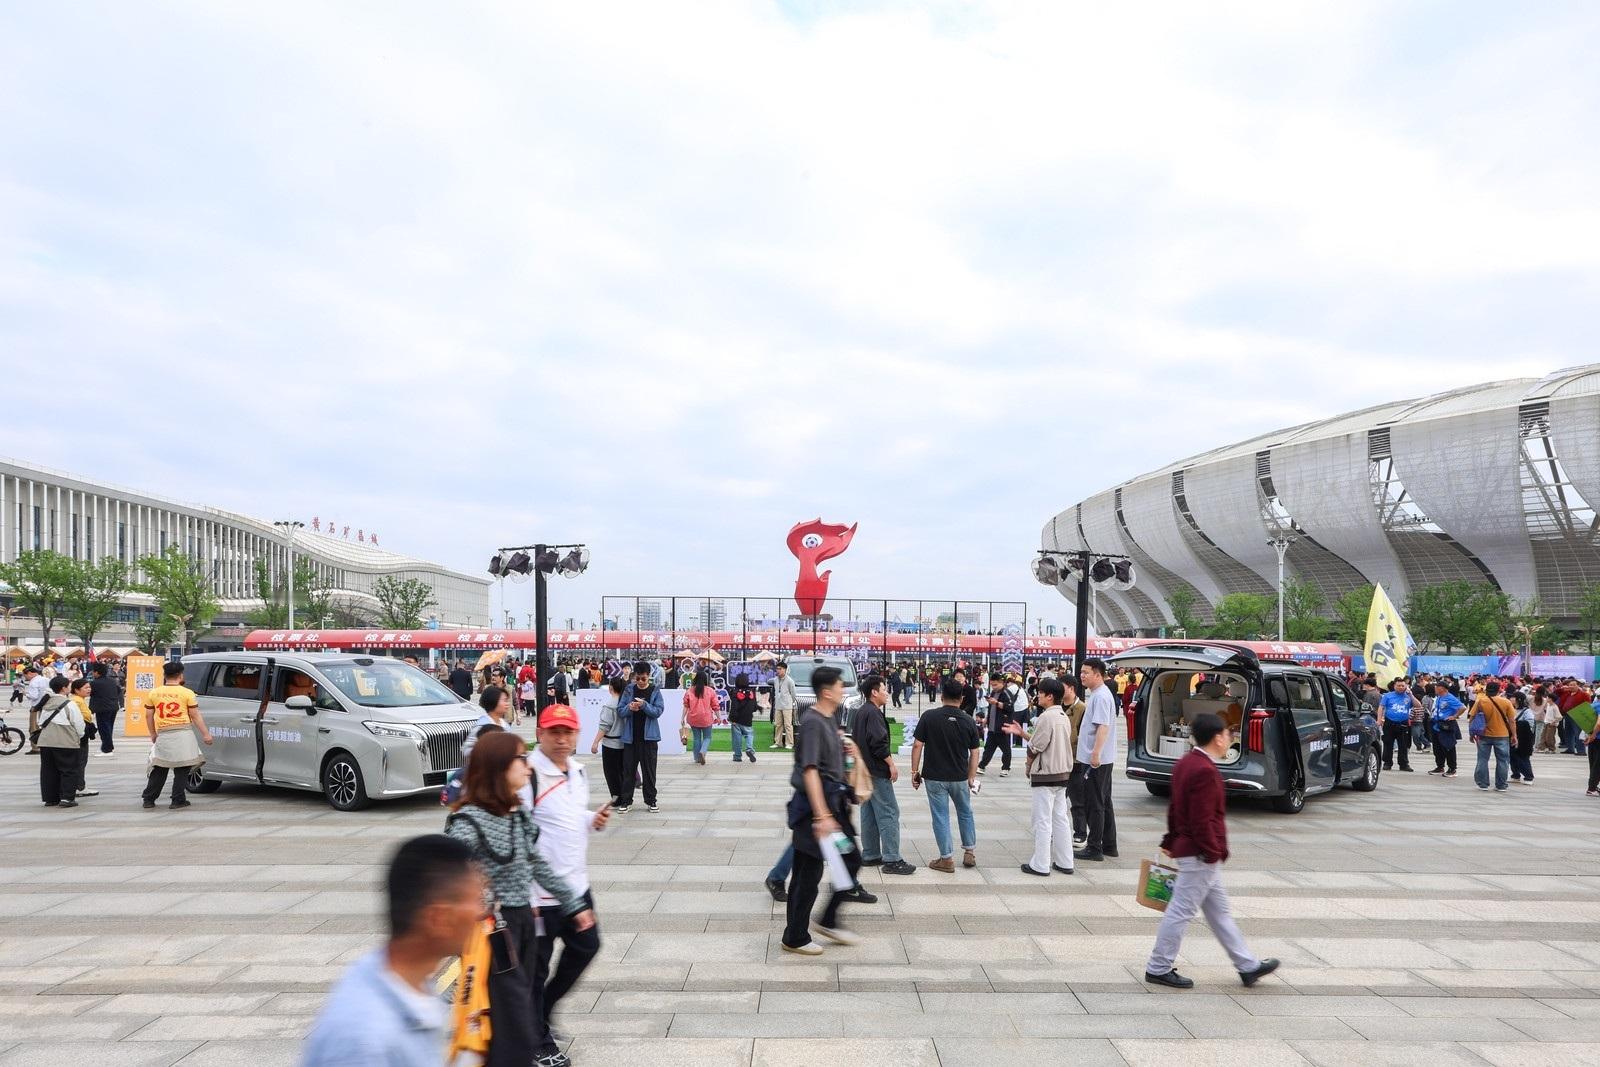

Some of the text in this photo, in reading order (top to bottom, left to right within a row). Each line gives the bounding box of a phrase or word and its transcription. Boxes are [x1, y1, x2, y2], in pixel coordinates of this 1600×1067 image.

[271, 633, 320, 641] 检票处
[365, 633, 413, 641] 检票处
[457, 633, 505, 642] 检票处
[550, 633, 597, 642] 检票处
[733, 634, 778, 643] 检票处
[825, 635, 871, 644] 检票处
[915, 637, 961, 646] 检票处
[156, 701, 183, 719] 12
